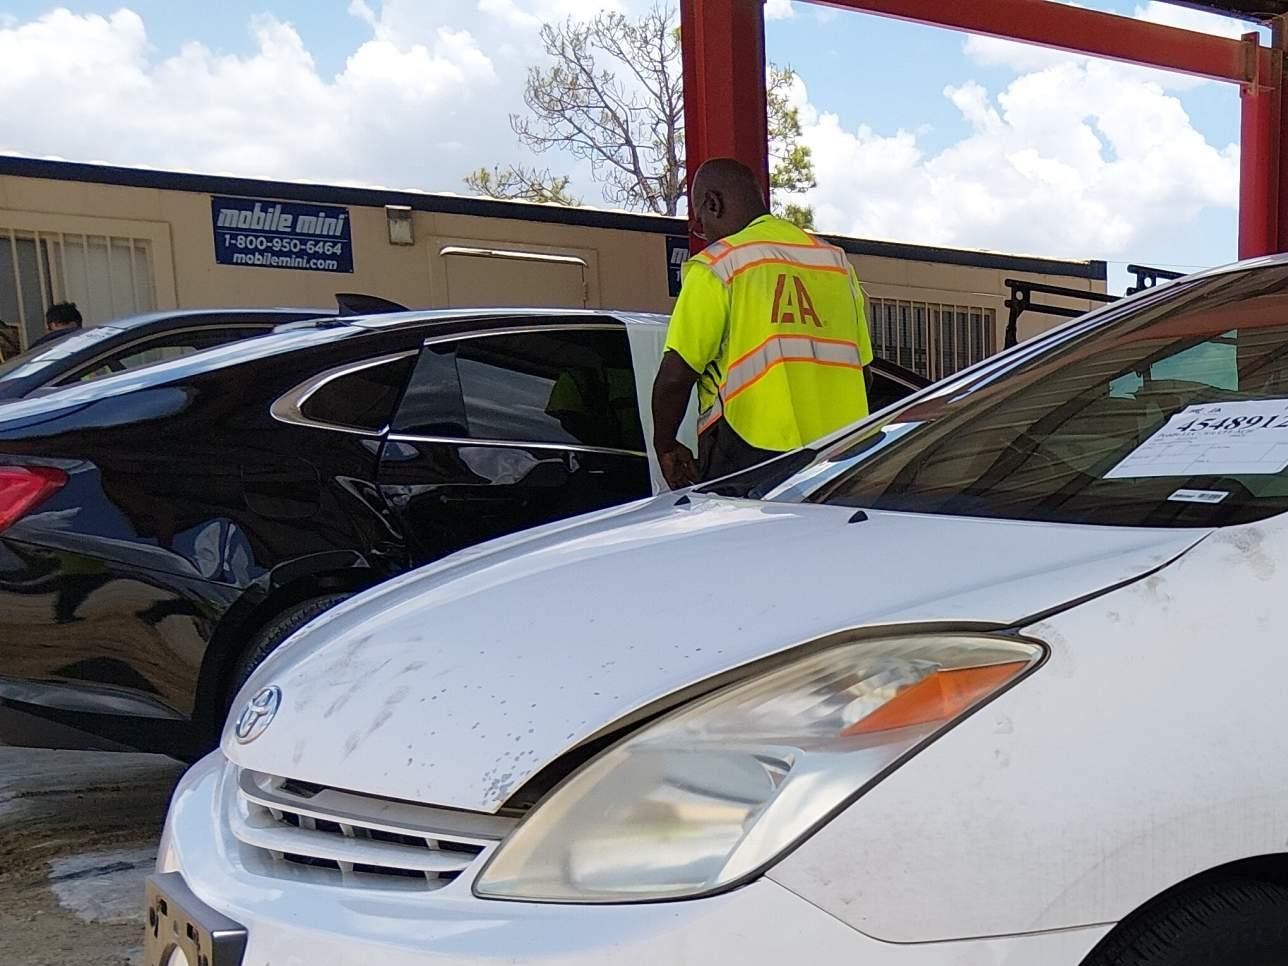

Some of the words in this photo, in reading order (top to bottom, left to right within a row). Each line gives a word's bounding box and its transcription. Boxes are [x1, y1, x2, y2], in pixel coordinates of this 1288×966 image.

[218, 204, 293, 231] mobile
[297, 213, 345, 235] mini
[224, 234, 342, 256] 1-800-950-6464
[233, 253, 338, 270] mobilemini.com
